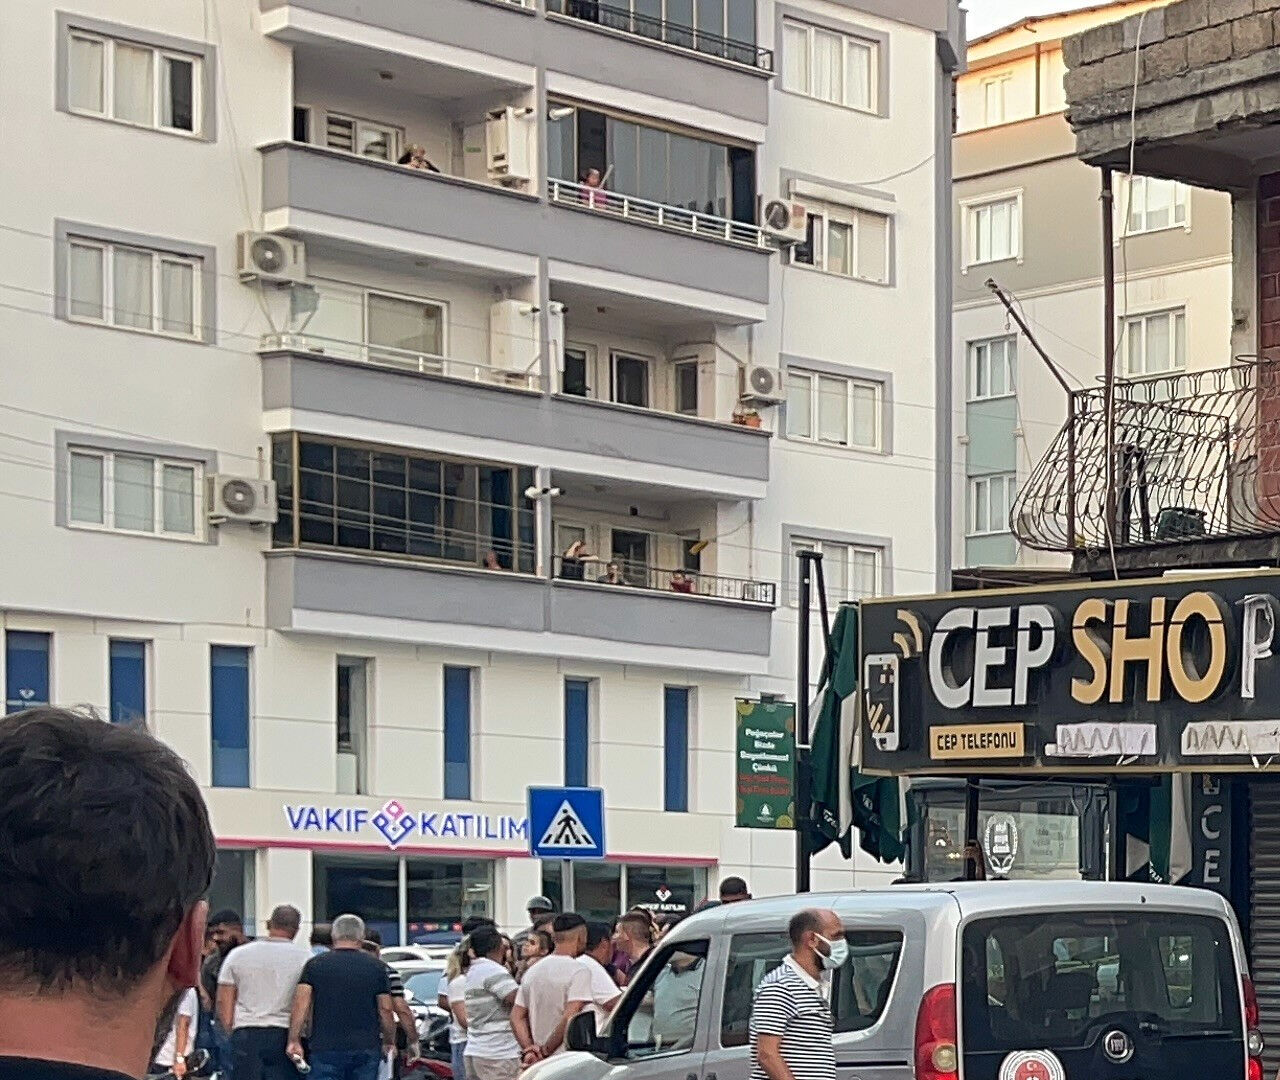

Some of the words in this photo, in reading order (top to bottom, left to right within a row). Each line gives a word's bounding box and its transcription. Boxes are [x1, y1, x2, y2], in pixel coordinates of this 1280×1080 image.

[929, 604, 1056, 709] CEP
[936, 733, 960, 751] CEP
[960, 728, 1018, 749] TELEFONU
[285, 805, 370, 832] VAKIF
[419, 812, 530, 839] KATILIM
